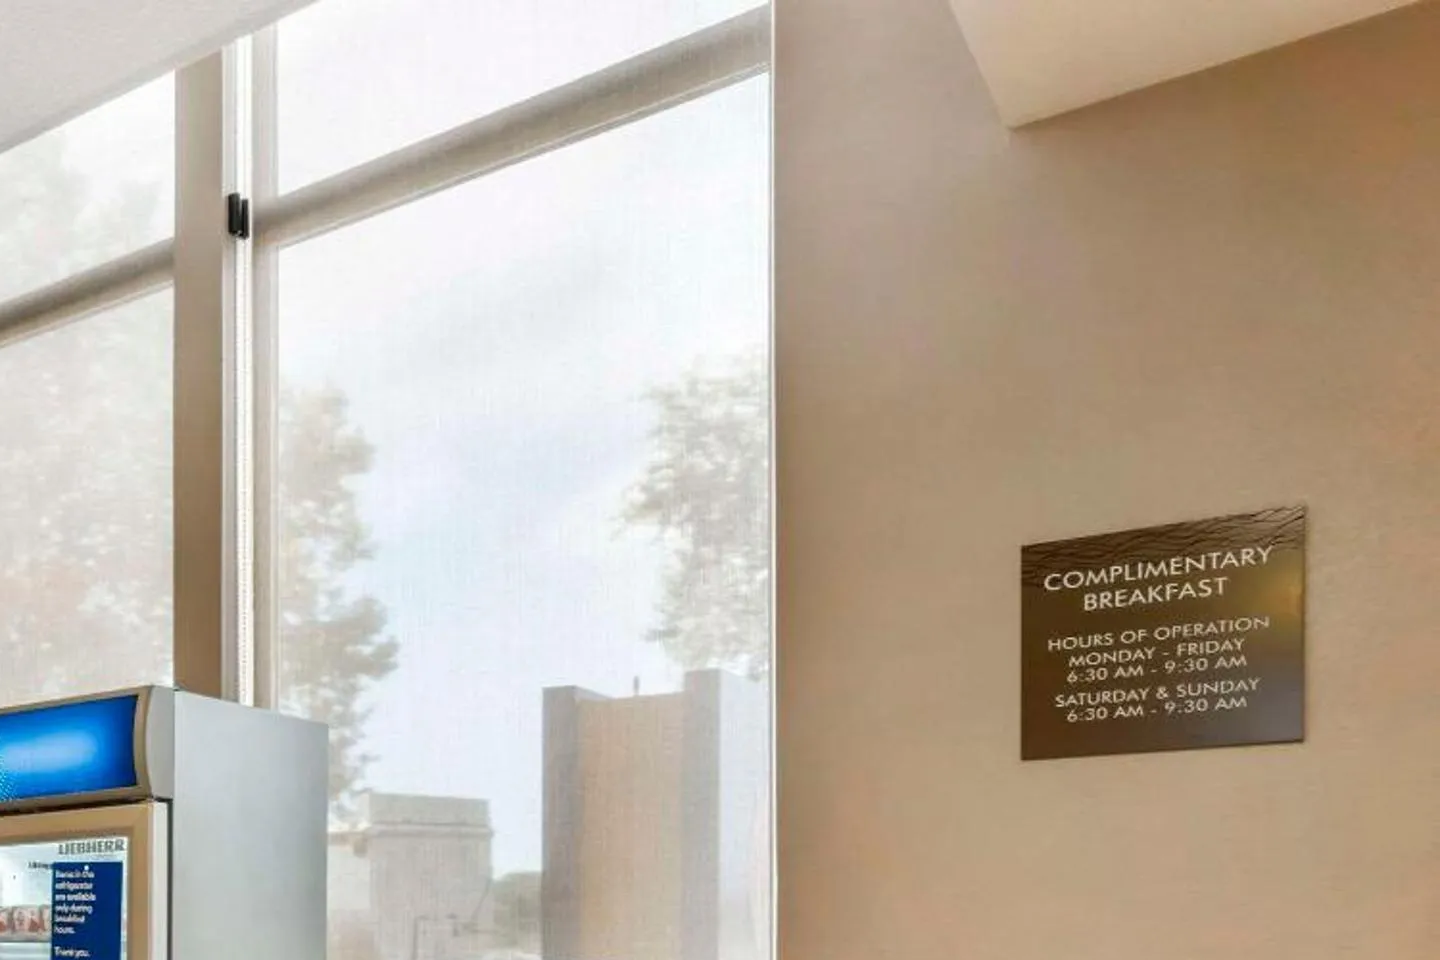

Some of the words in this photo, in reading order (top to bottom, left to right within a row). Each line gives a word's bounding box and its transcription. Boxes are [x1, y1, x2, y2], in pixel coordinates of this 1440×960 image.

[1044, 545, 1273, 591] COMPLIMENTARY
[1084, 576, 1229, 611] BREAKFAST
[1048, 632, 1114, 652] HOURS
[1120, 629, 1148, 645] OF
[1153, 616, 1271, 641] OPERATION
[1068, 646, 1156, 668] MONDAY
[1176, 638, 1246, 656] FRIDAY
[1066, 667, 1109, 684] 6:30
[1113, 664, 1144, 679] AM
[1164, 657, 1209, 675] 9:30
[1214, 654, 1248, 670] AM
[1055, 687, 1150, 708] SATURDAY
[1155, 686, 1168, 700] &
[1176, 677, 1261, 699] SUNDAY
[1066, 706, 1109, 723] 6:30
[1113, 704, 1144, 719] AM
[1164, 698, 1209, 715] 9:30
[1214, 696, 1248, 710] AM
[58, 839, 125, 855] LIEBHERR
